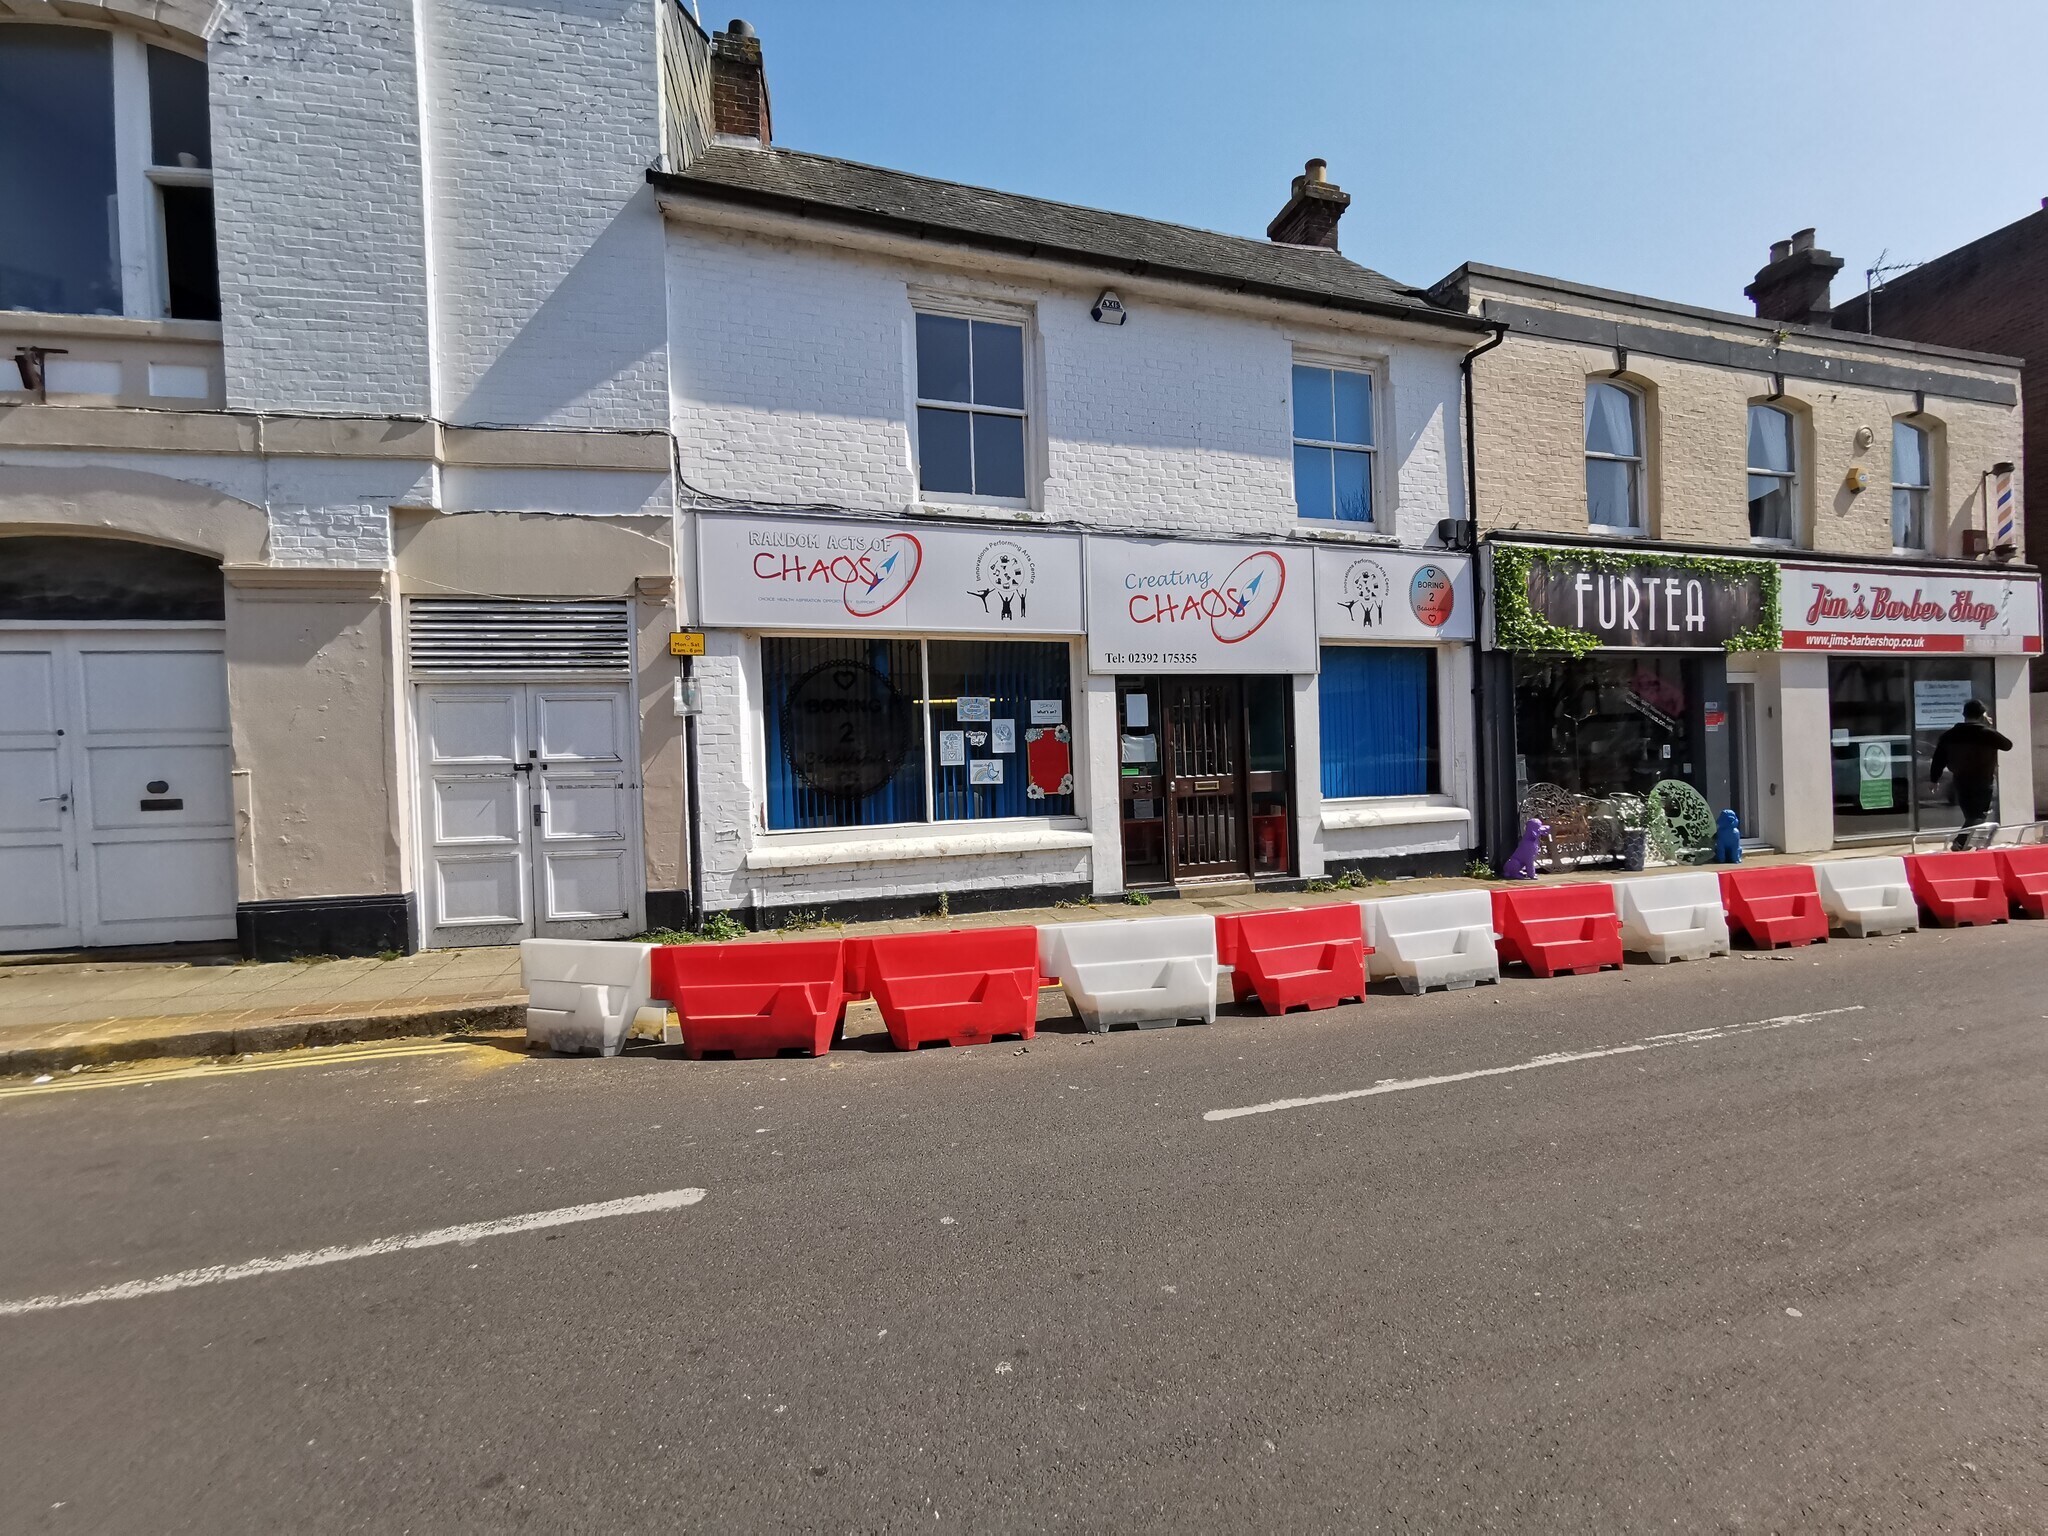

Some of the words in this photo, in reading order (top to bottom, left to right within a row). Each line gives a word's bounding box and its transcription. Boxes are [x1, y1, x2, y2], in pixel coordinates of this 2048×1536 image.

[749, 531, 820, 549] RANDOM
[827, 535, 866, 550] ACTS
[871, 538, 892, 552] OF
[753, 552, 878, 586] CHAOS
[976, 547, 989, 582] Innovations
[989, 540, 1022, 552] Performing
[1022, 549, 1032, 562] Arts
[1125, 570, 1213, 590] Creating
[1417, 581, 1445, 590] BORING
[1129, 588, 1246, 624] CHAOS
[1429, 592, 1435, 602] 2
[1575, 573, 1705, 632] FURTEA
[1806, 582, 1870, 625] Jim's
[1870, 586, 1946, 623] Barber
[1948, 590, 1999, 629] Shop
[1806, 634, 1925, 649] www.jims-barbershop.co.uk
[1105, 653, 1125, 664] Tel:
[1128, 653, 1159, 664] 02392
[1163, 654, 1198, 664] 175355
[805, 698, 881, 713] BORING
[840, 722, 854, 743] 2
[1133, 782, 1153, 792] 3-5
